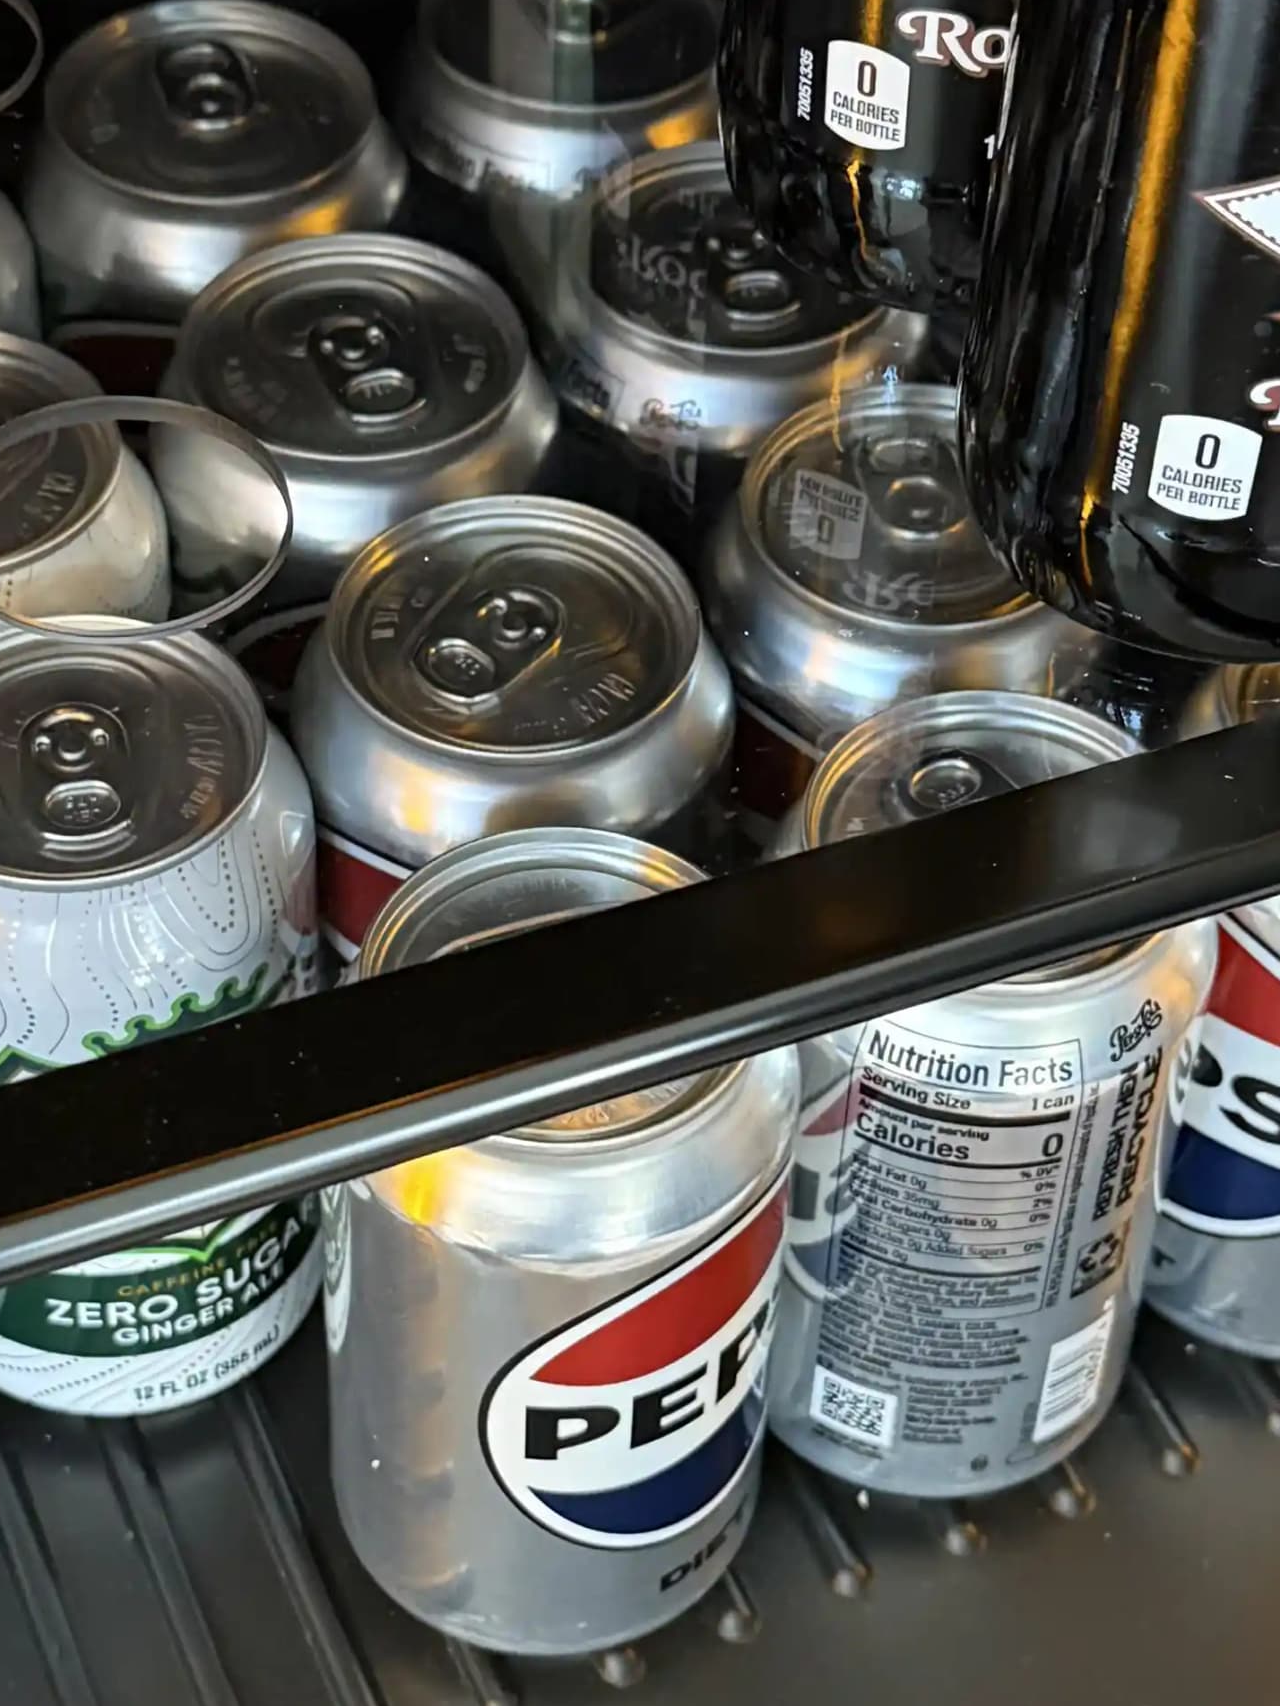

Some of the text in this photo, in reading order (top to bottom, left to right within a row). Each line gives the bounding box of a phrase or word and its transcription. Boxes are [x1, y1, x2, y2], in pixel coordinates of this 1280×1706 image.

[897, 10, 1010, 75] Ro
[796, 46, 814, 122] 70051335
[857, 59, 877, 98] 0
[830, 109, 901, 143] PER BOTTLE
[832, 90, 900, 125] CALORIES
[1111, 421, 1141, 495] 70051335
[1194, 433, 1221, 471] 0
[1156, 482, 1241, 512] PER BOTTLE
[1162, 463, 1243, 495] CALORIES
[868, 1029, 1073, 1088] Nutrition Facts
[861, 1066, 930, 1105] Serving
[932, 1090, 971, 1111] Size
[1043, 1093, 1075, 1111] can
[856, 1111, 1064, 1161] Calories 0
[858, 1097, 990, 1142] Amount per serving
[1115, 1045, 1163, 1209] RECYCLE
[884, 1167, 907, 1184] Fat
[1091, 1129, 1124, 1222] REFRESH
[880, 1197, 978, 1228] Carbohydrate
[924, 1243, 964, 1256] Added
[117, 1257, 226, 1296] CAFFEINE
[44, 1294, 179, 1329] ZERO
[111, 1256, 284, 1346] GINGER ALE
[133, 1384, 155, 1401] 12
[159, 1376, 182, 1394] FL
[186, 1369, 209, 1388] OZ
[524, 1298, 769, 1461] PEP
